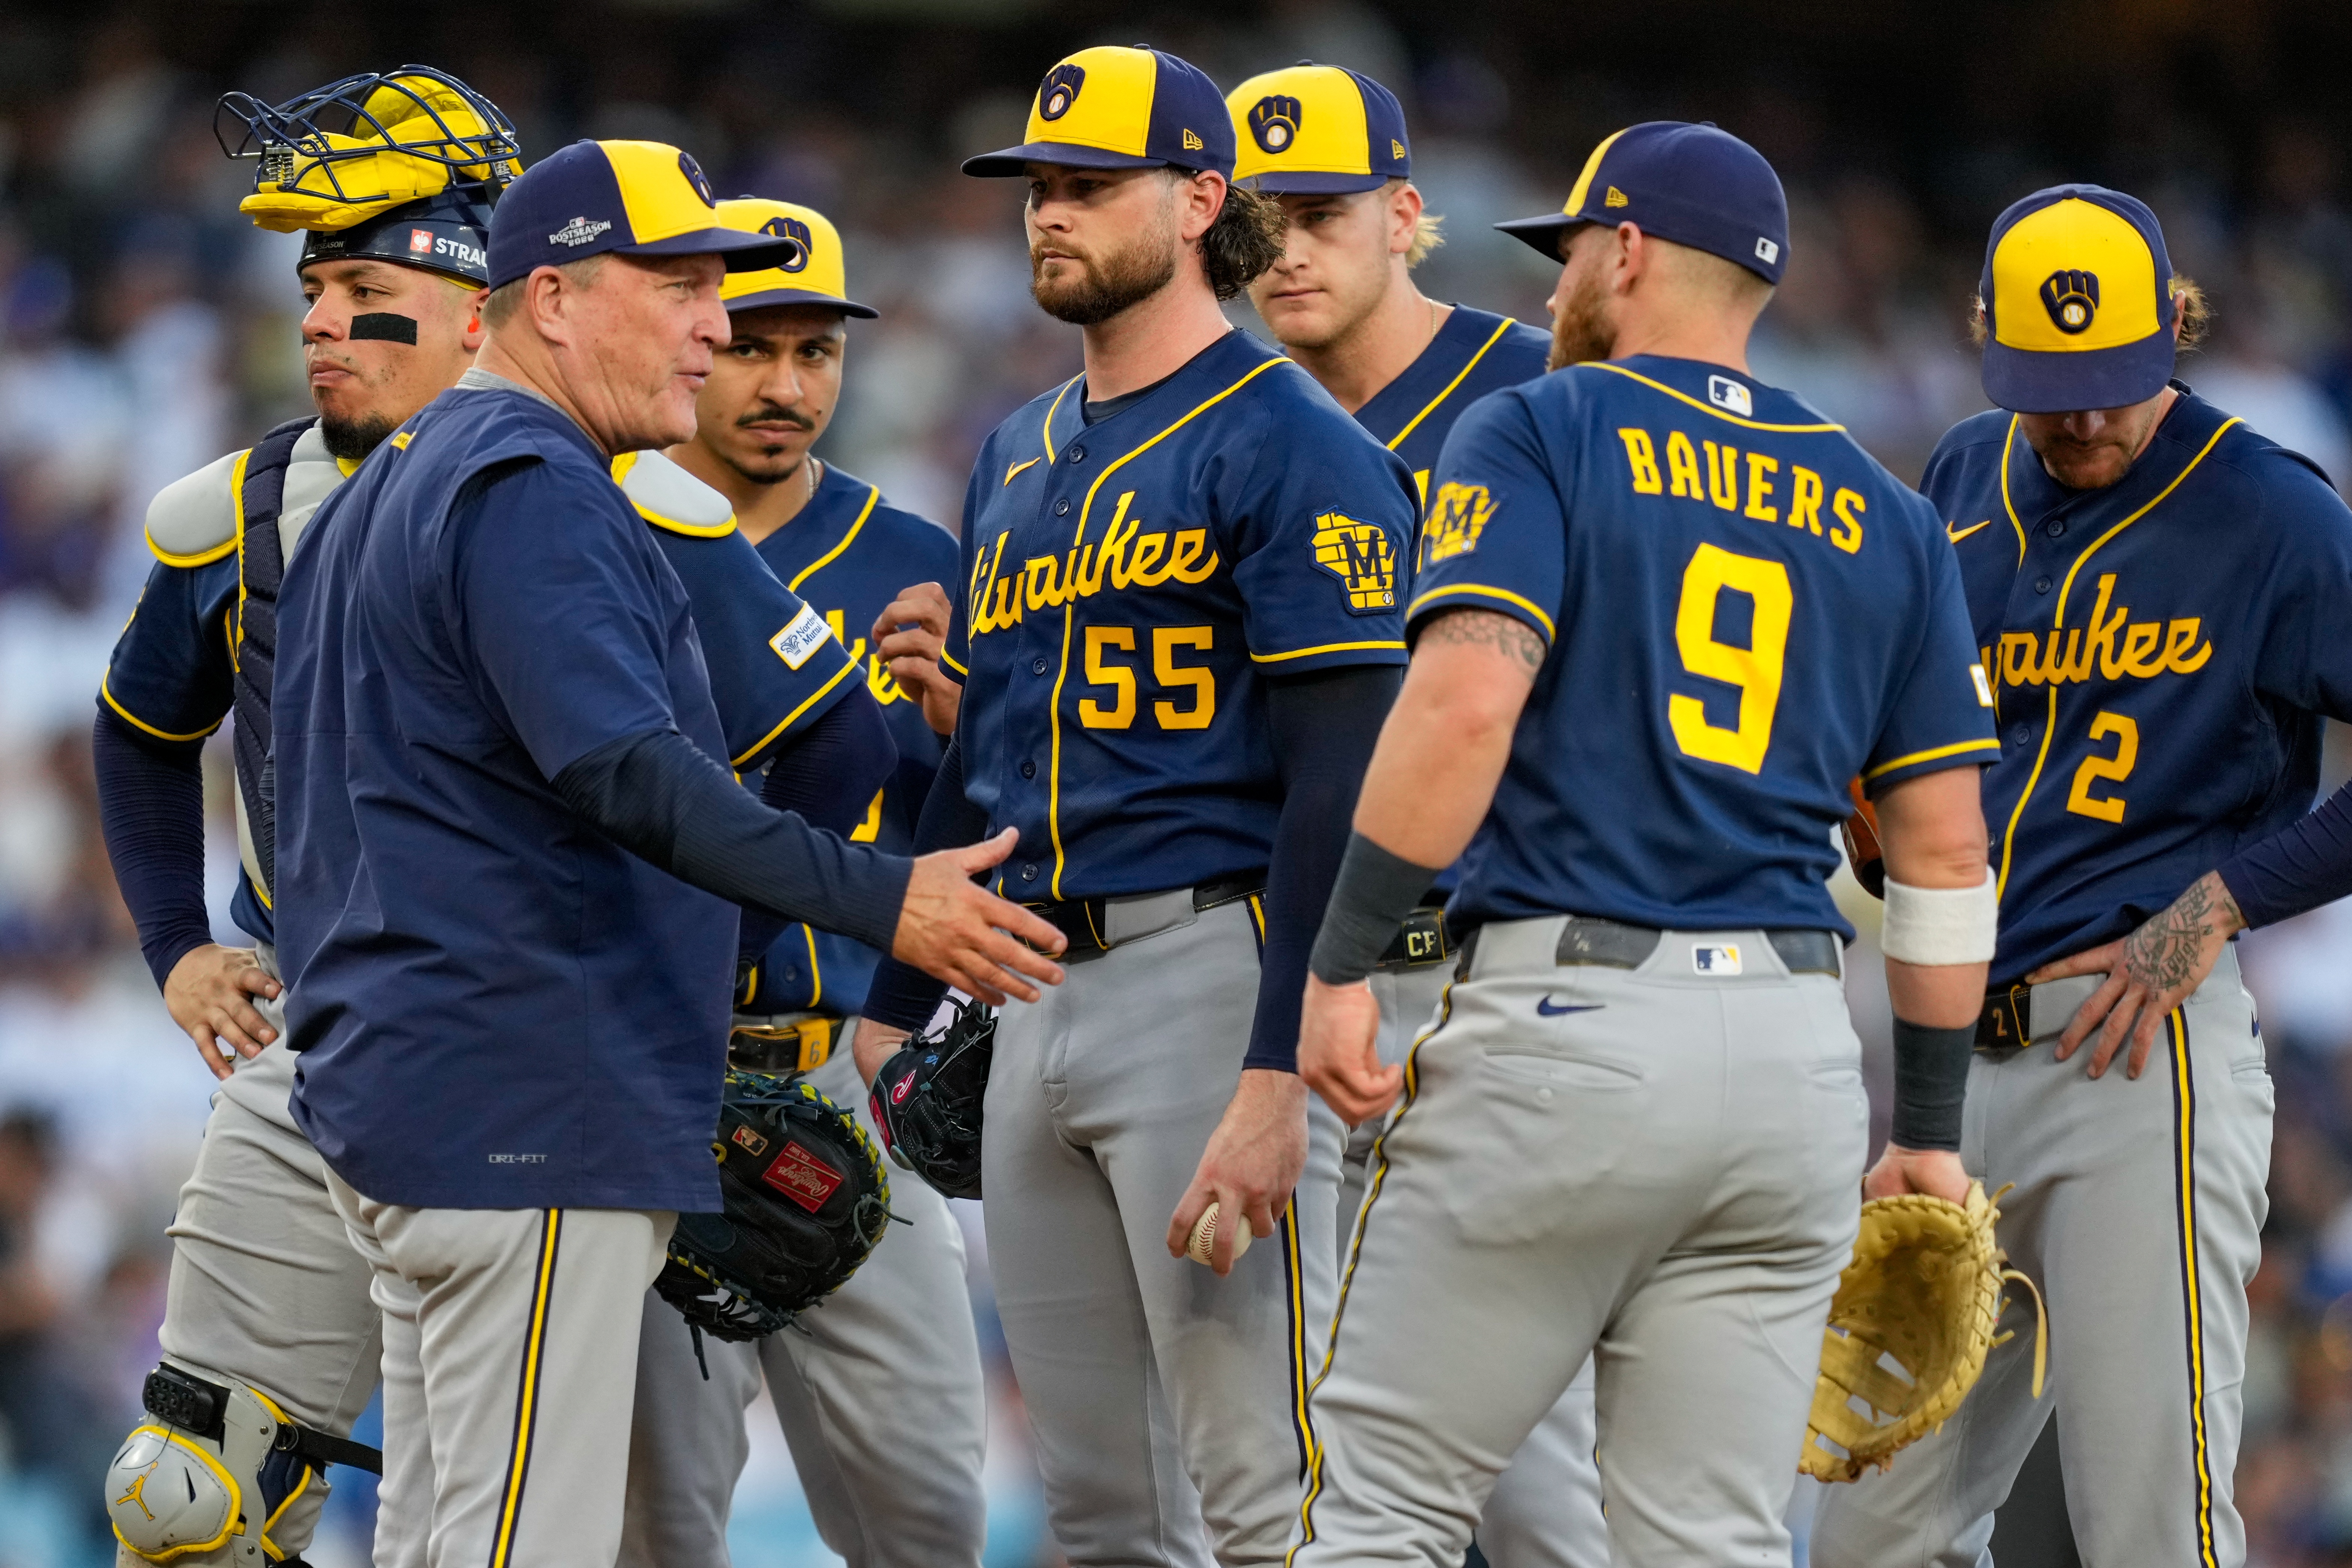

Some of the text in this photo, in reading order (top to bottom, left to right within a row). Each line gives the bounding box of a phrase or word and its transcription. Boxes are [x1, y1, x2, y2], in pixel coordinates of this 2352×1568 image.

[549, 220, 611, 245] POSTSEASON
[1618, 428, 1866, 554] BAUERS
[802, 622, 823, 645] Mutual
[1669, 543, 1794, 774] 9
[1078, 626, 1215, 729] 55
[2066, 711, 2139, 823] 2
[1407, 930, 1436, 957] CF
[1992, 1008, 2007, 1037] 2
[809, 1040, 821, 1065] 6
[489, 1154, 548, 1163] DRI-FIT
[778, 1164, 829, 1197] Rawlings
